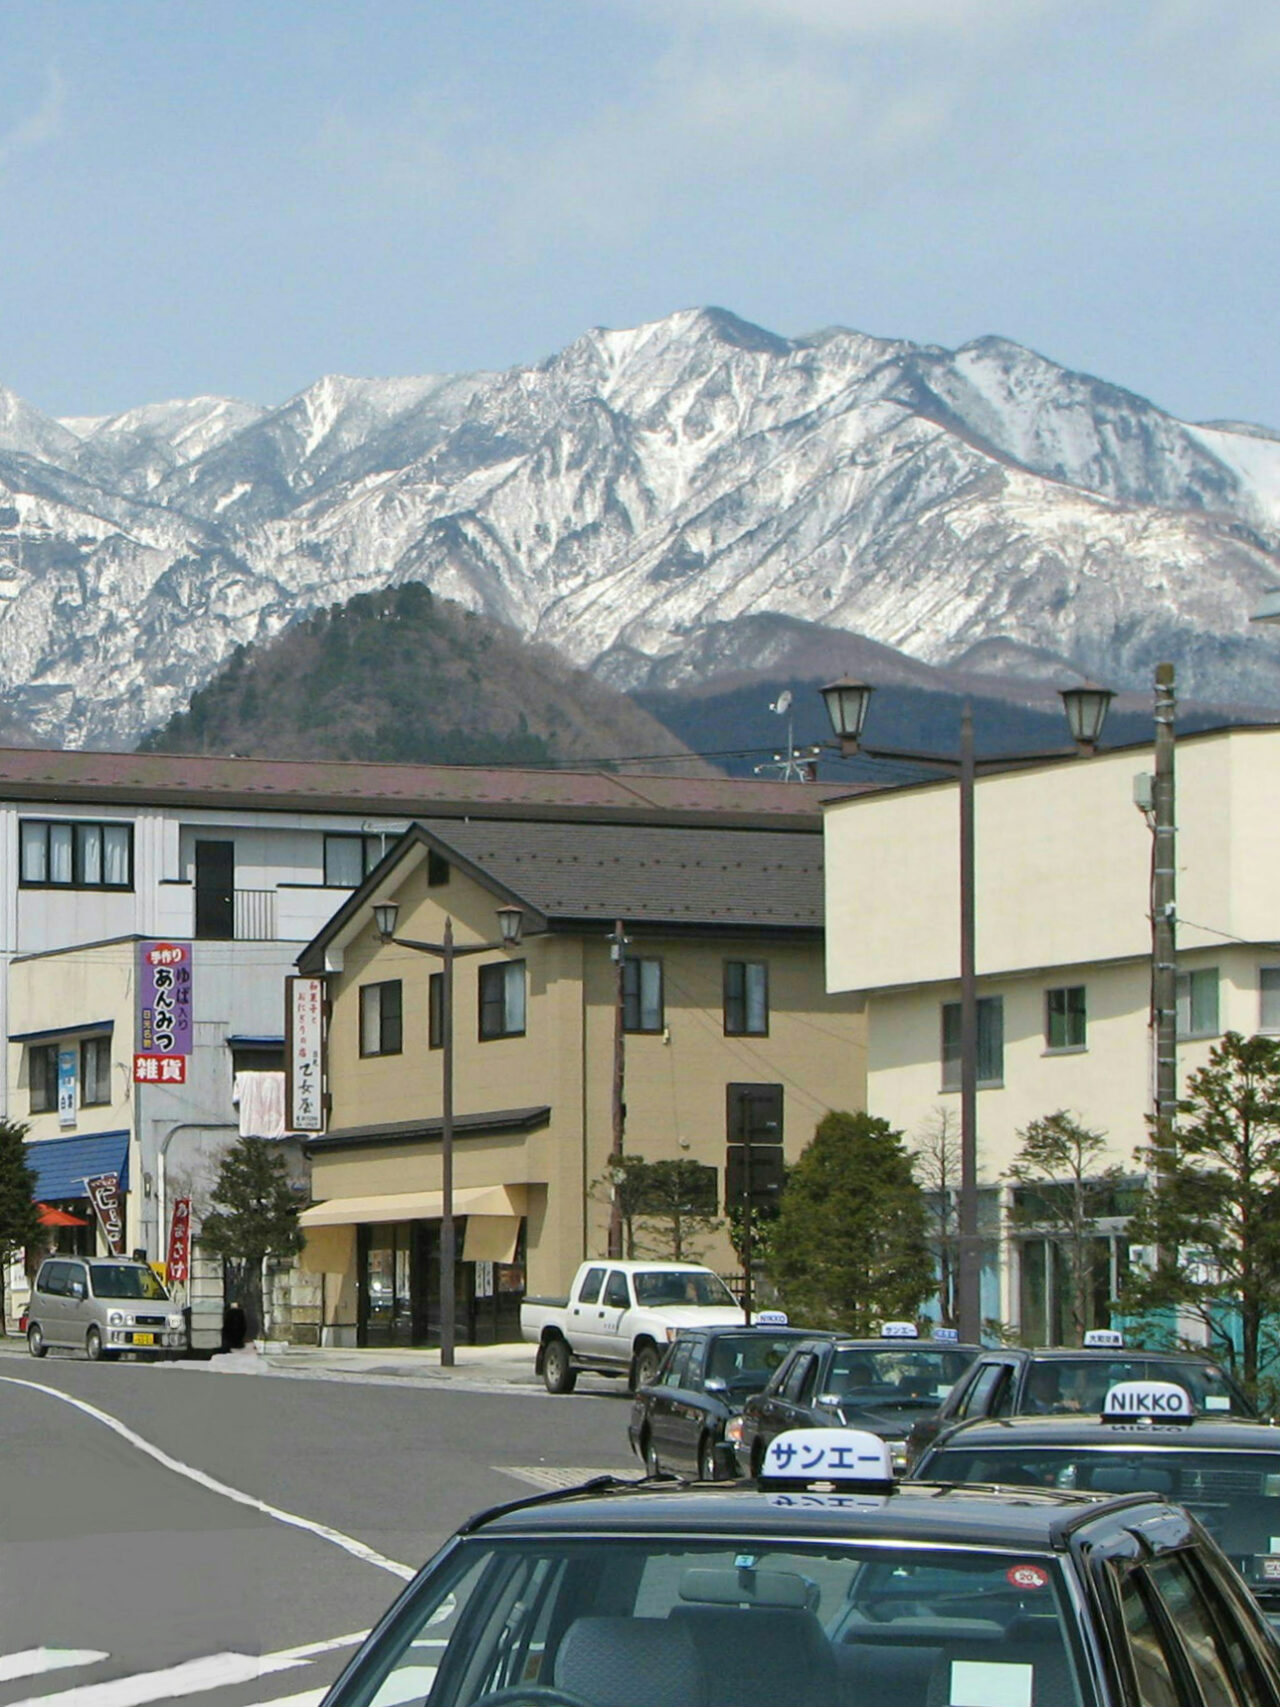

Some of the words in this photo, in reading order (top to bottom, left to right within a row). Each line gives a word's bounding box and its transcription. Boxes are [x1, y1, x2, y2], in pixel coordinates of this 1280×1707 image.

[150, 948, 182, 964] 手作り
[153, 966, 175, 1053] あんみつ
[176, 967, 190, 1031] ゆば入り
[136, 1058, 182, 1081] 雑貨
[1111, 1393, 1183, 1412] NIKKO
[771, 1443, 880, 1469] サンエー
